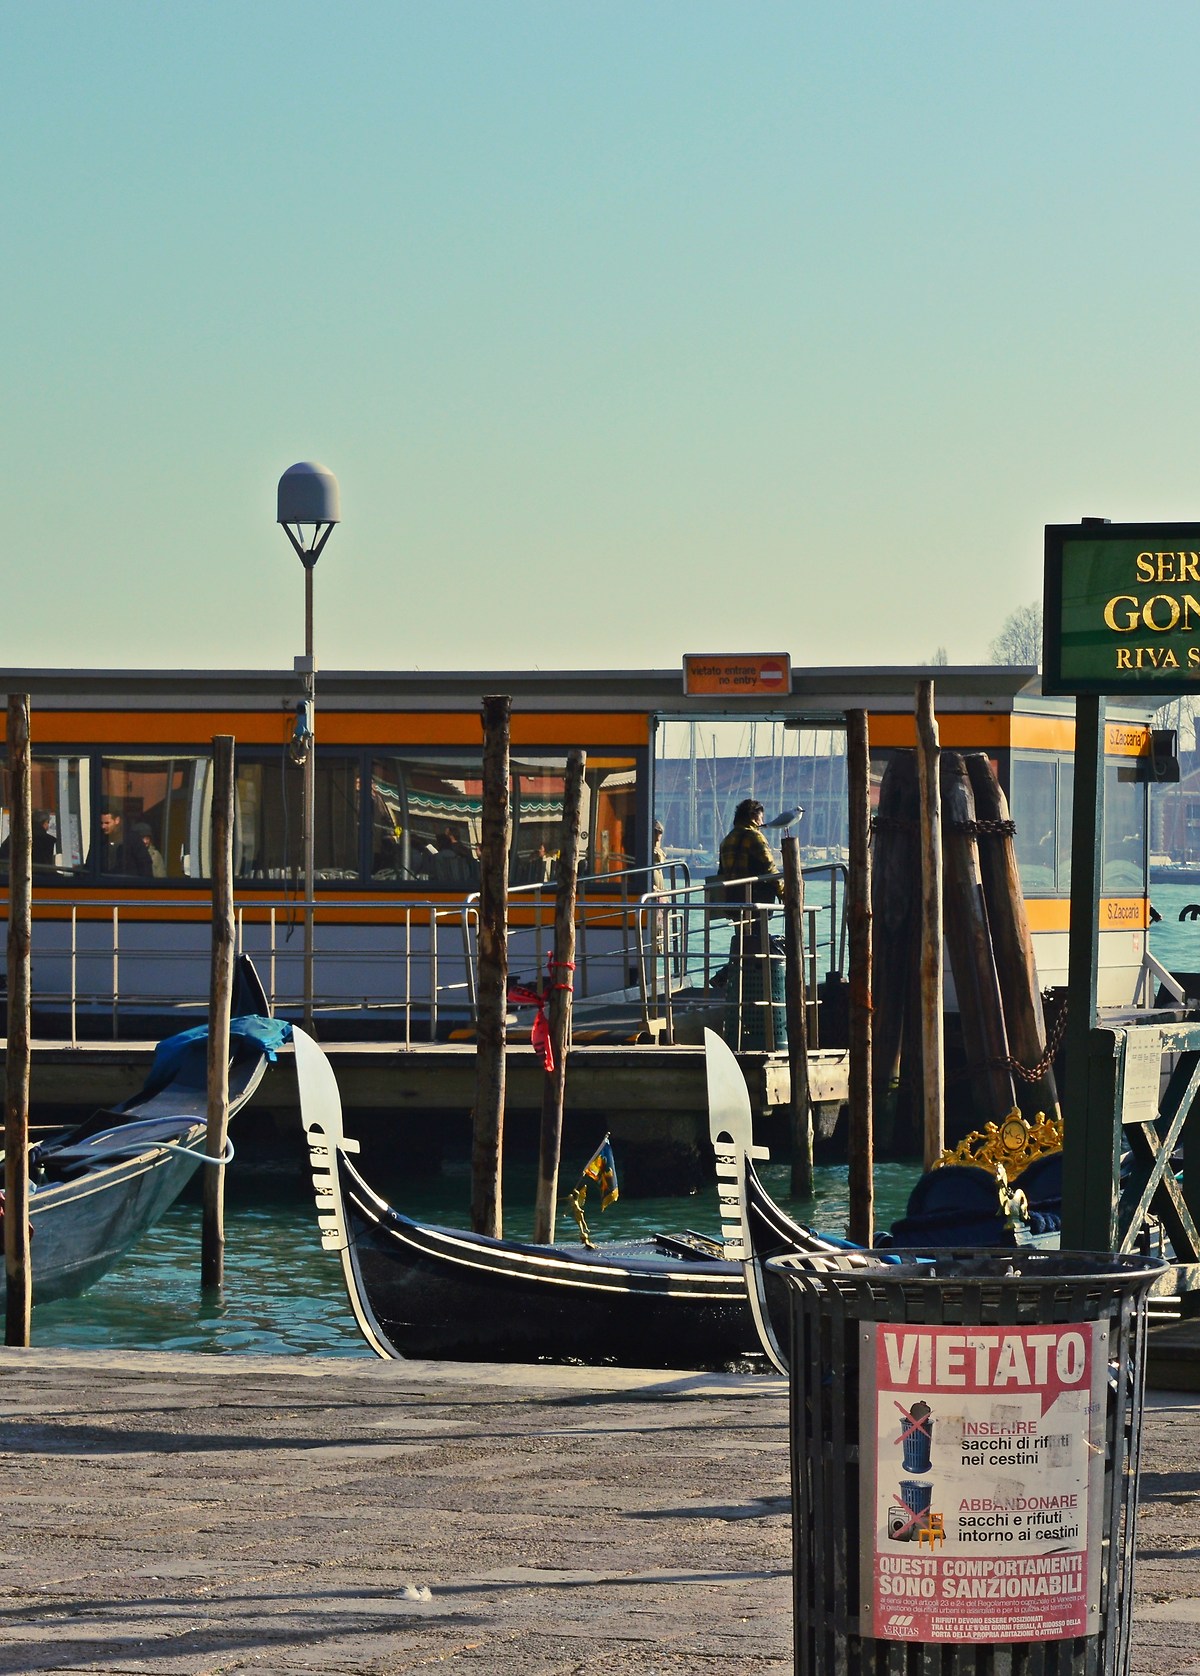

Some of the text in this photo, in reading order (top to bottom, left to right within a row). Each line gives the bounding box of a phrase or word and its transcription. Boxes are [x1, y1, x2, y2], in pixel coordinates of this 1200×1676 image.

[1115, 647, 1180, 669] RIVA
[691, 666, 756, 676] vietato entrare
[734, 676, 758, 686] entry
[884, 1332, 1086, 1386] VIETATO
[962, 1437, 1012, 1450] sacchi
[1016, 1436, 1030, 1450] di
[962, 1452, 1038, 1466] nei cestini
[958, 1510, 1062, 1526] sacchi e rifiuti
[958, 1524, 1078, 1542] intorno ai cestini
[879, 1555, 1082, 1576] QUESTI COMPORTAMENTI
[879, 1573, 1082, 1599] SONO SANZIONABILI
[978, 1600, 1020, 1608] Regolamento
[884, 1625, 919, 1636] VERITAS
